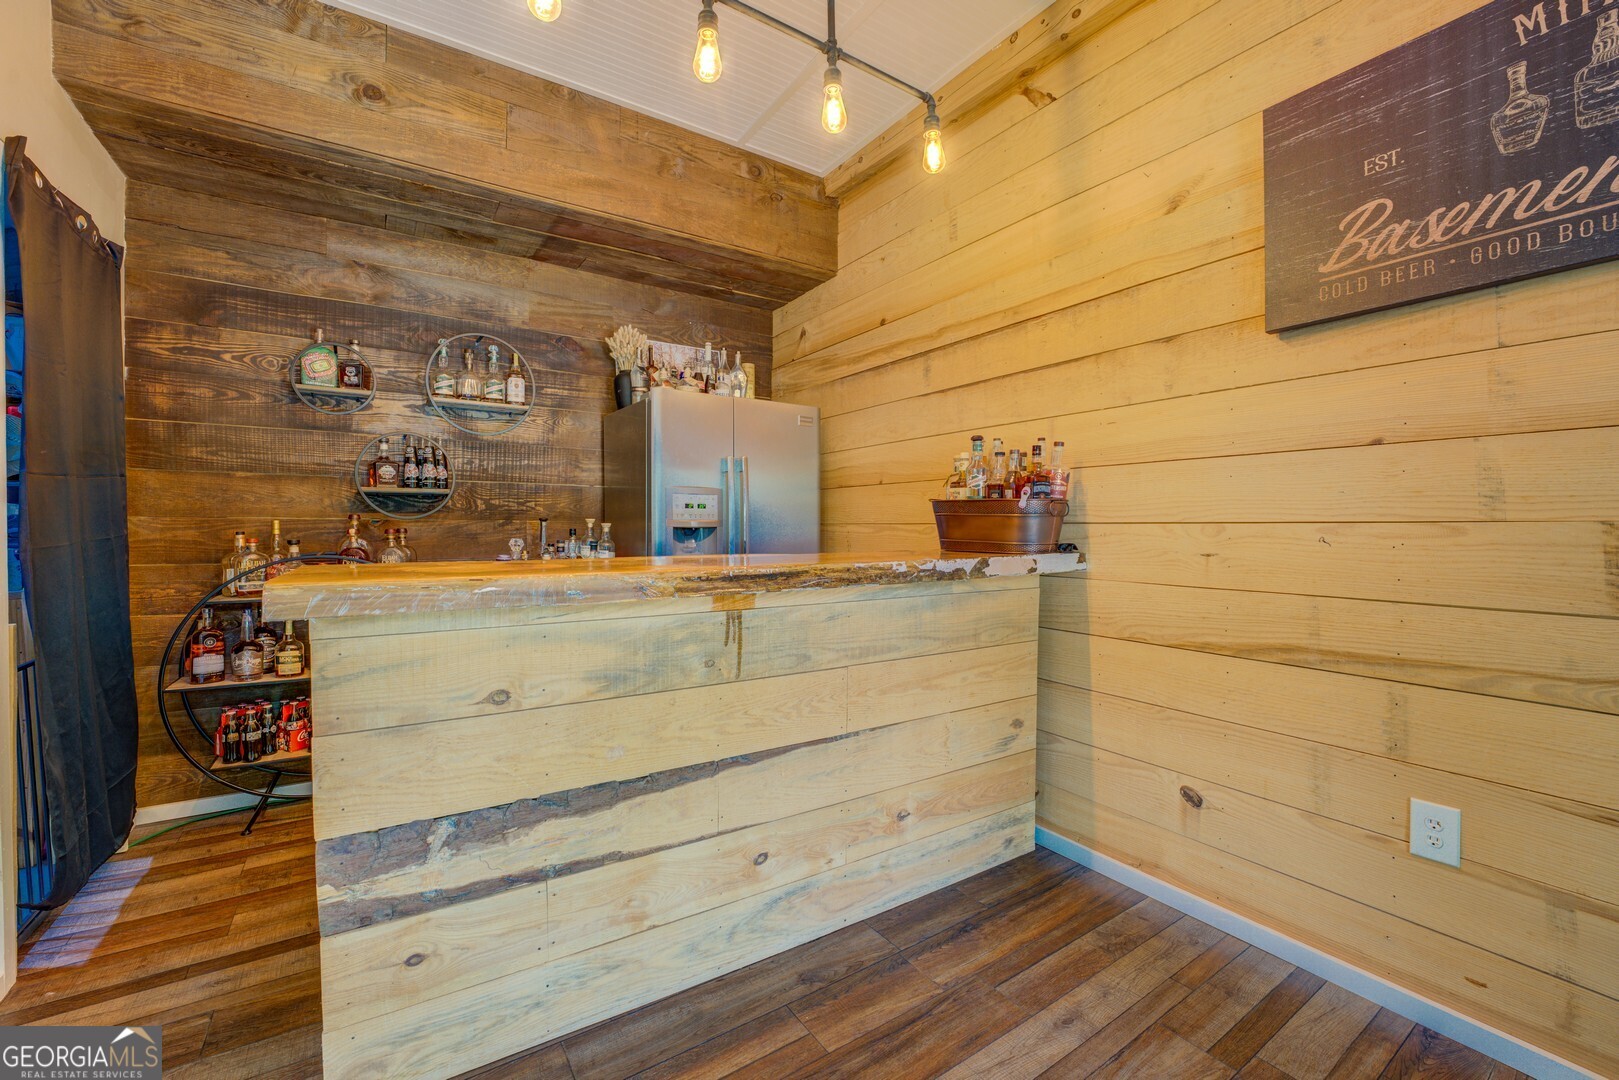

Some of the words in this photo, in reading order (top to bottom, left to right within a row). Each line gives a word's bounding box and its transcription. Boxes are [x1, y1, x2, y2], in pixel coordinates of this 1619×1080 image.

[1364, 149, 1405, 176] EST.
[1319, 277, 1368, 302] COLD
[1381, 259, 1435, 287] BEER
[1471, 232, 1541, 264] GOOD
[1558, 212, 1618, 244] BOU
